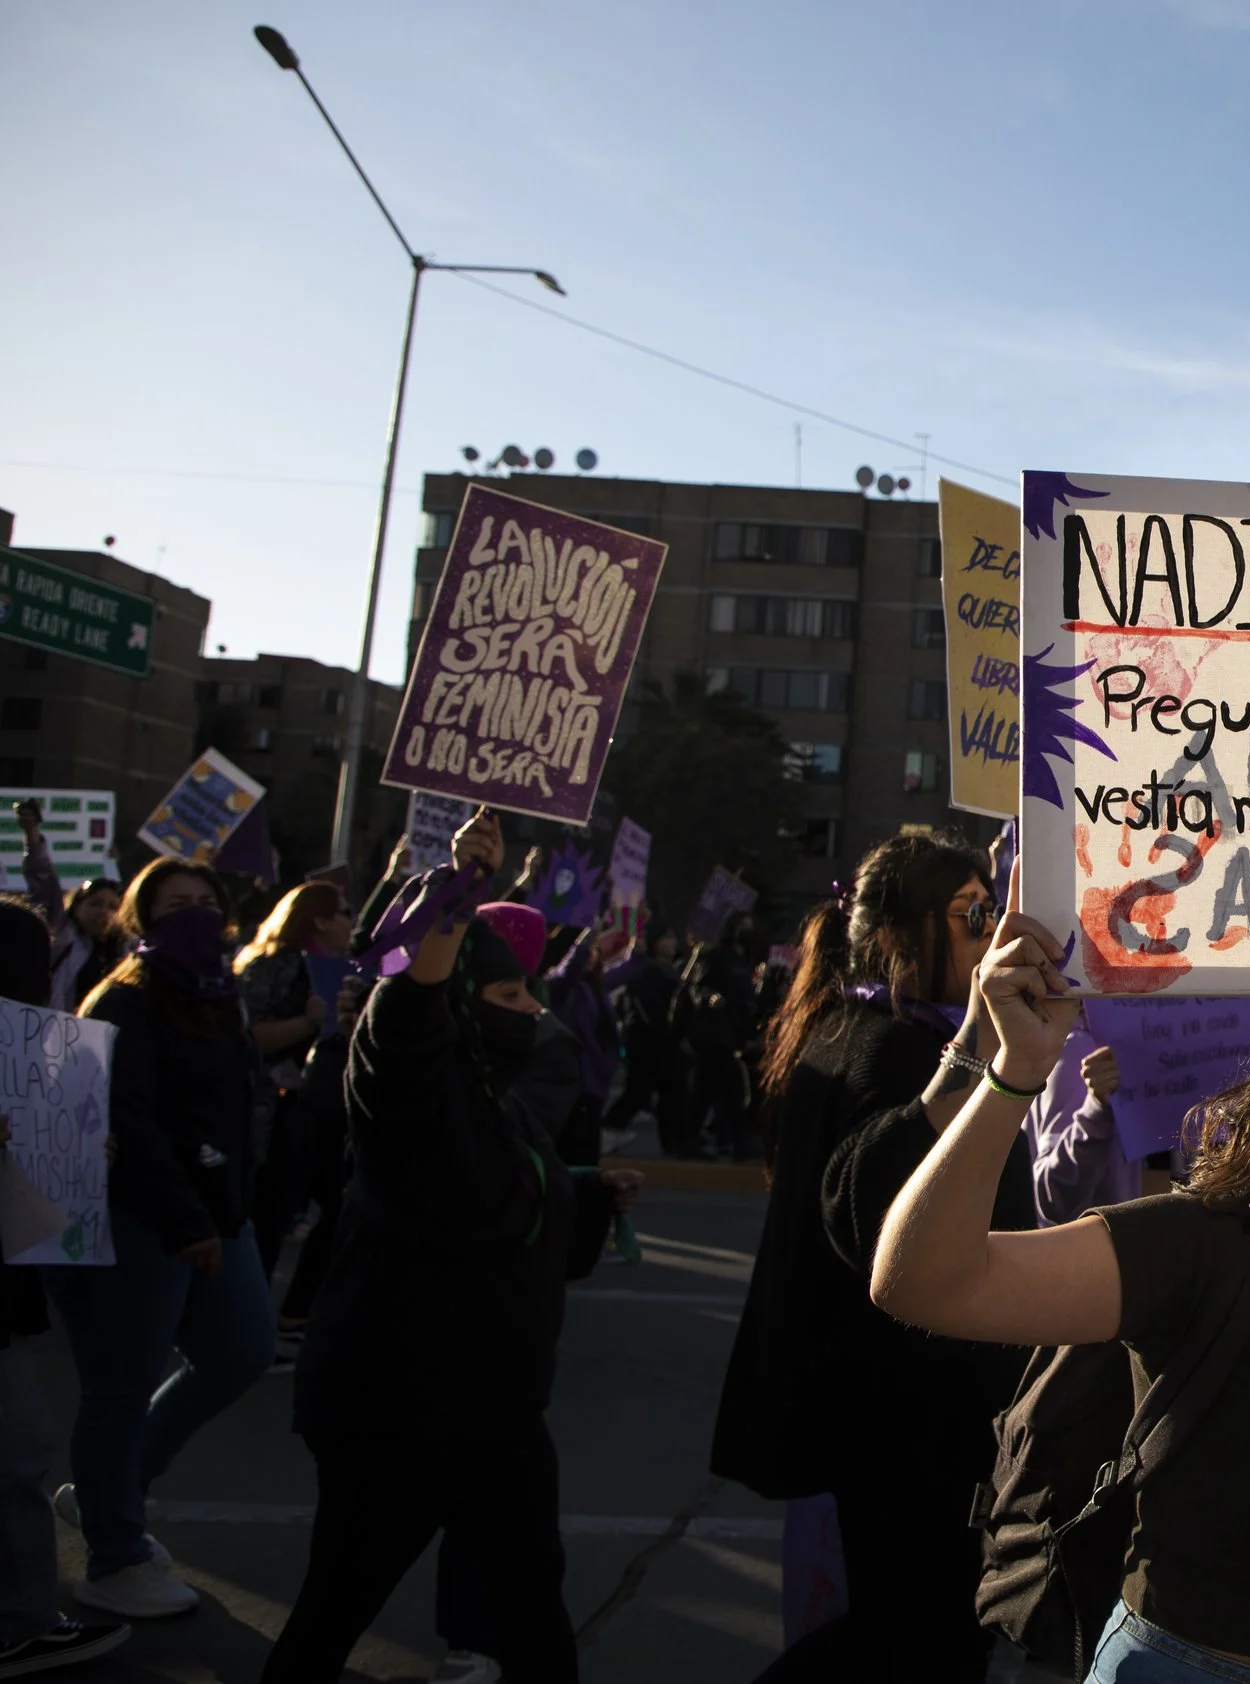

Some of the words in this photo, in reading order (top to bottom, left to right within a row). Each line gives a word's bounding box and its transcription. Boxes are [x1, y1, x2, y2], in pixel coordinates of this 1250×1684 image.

[468, 515, 532, 565] LA
[21, 604, 71, 641] READY
[74, 621, 111, 653] LANE
[405, 725, 426, 766] O
[427, 728, 467, 776] NO
[422, 671, 603, 784] FEMINISTA
[1074, 769, 1216, 838] vestía
[19, 1007, 80, 1067] POR
